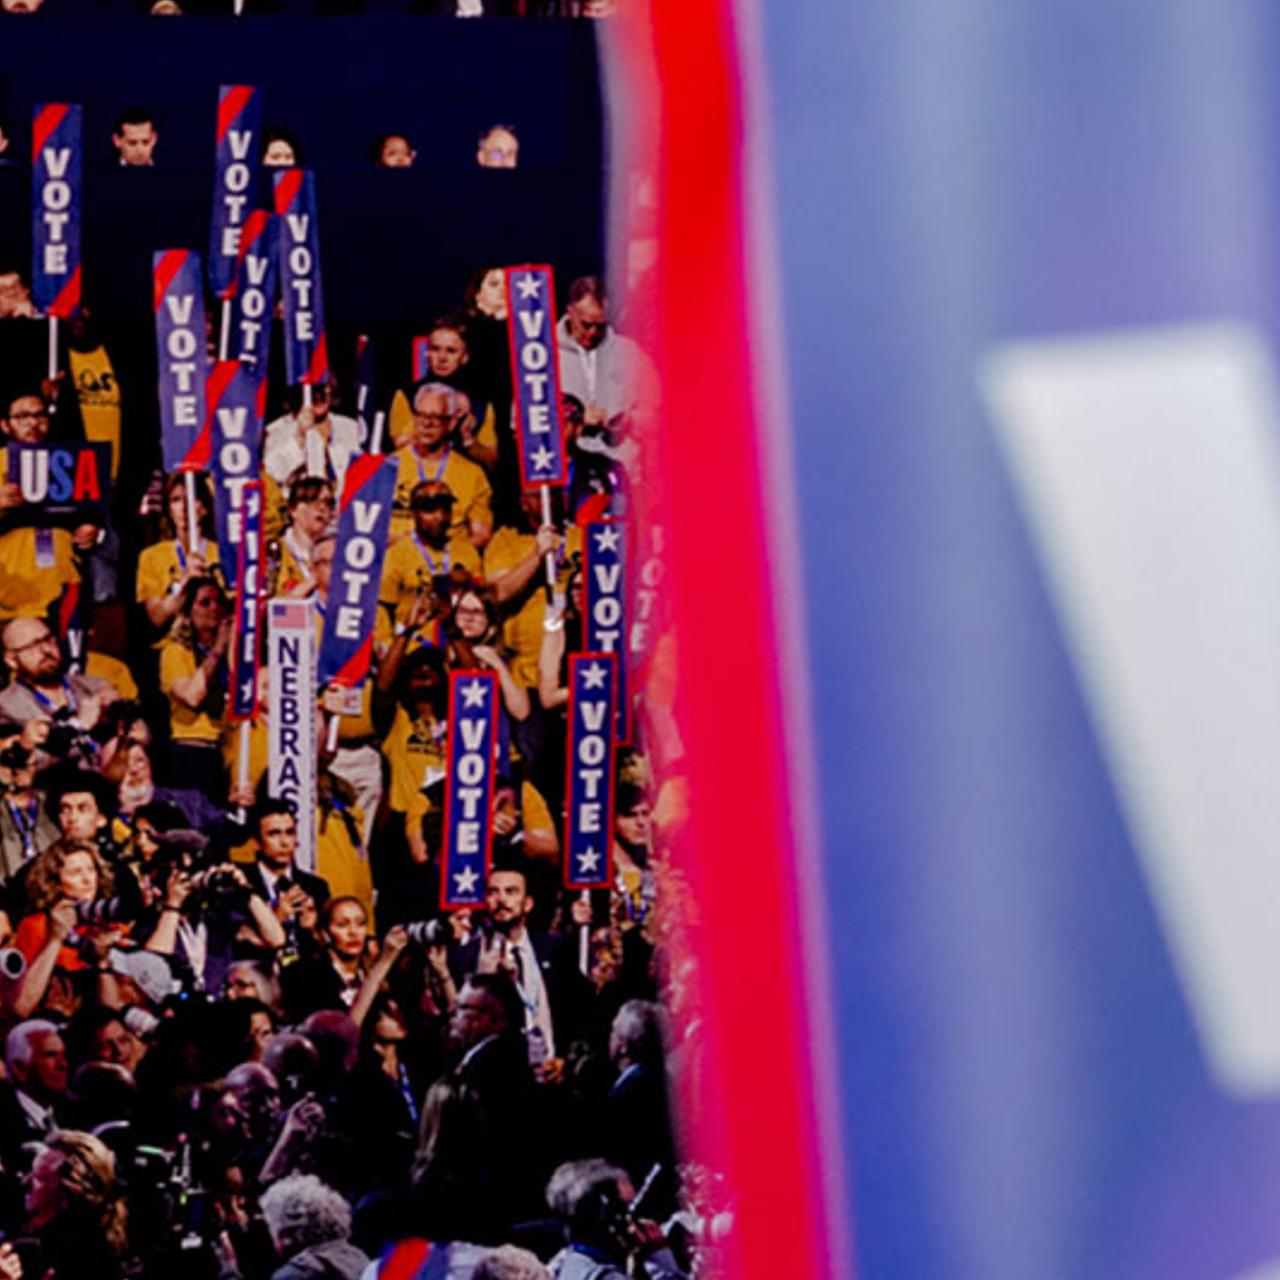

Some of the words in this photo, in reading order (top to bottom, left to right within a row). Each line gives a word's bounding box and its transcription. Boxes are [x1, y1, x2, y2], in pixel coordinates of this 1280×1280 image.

[42, 148, 71, 274] VOTE
[221, 130, 251, 256] VOTE
[287, 214, 313, 340] VOTE
[166, 295, 198, 426] VOTE
[519, 309, 550, 434] VOTE
[20, 449, 101, 503] USA
[335, 500, 382, 640] VOTE
[593, 566, 621, 653] VOT
[277, 636, 300, 813] NEBRAS
[455, 718, 486, 856] VOTE
[578, 702, 608, 834] VOTE
